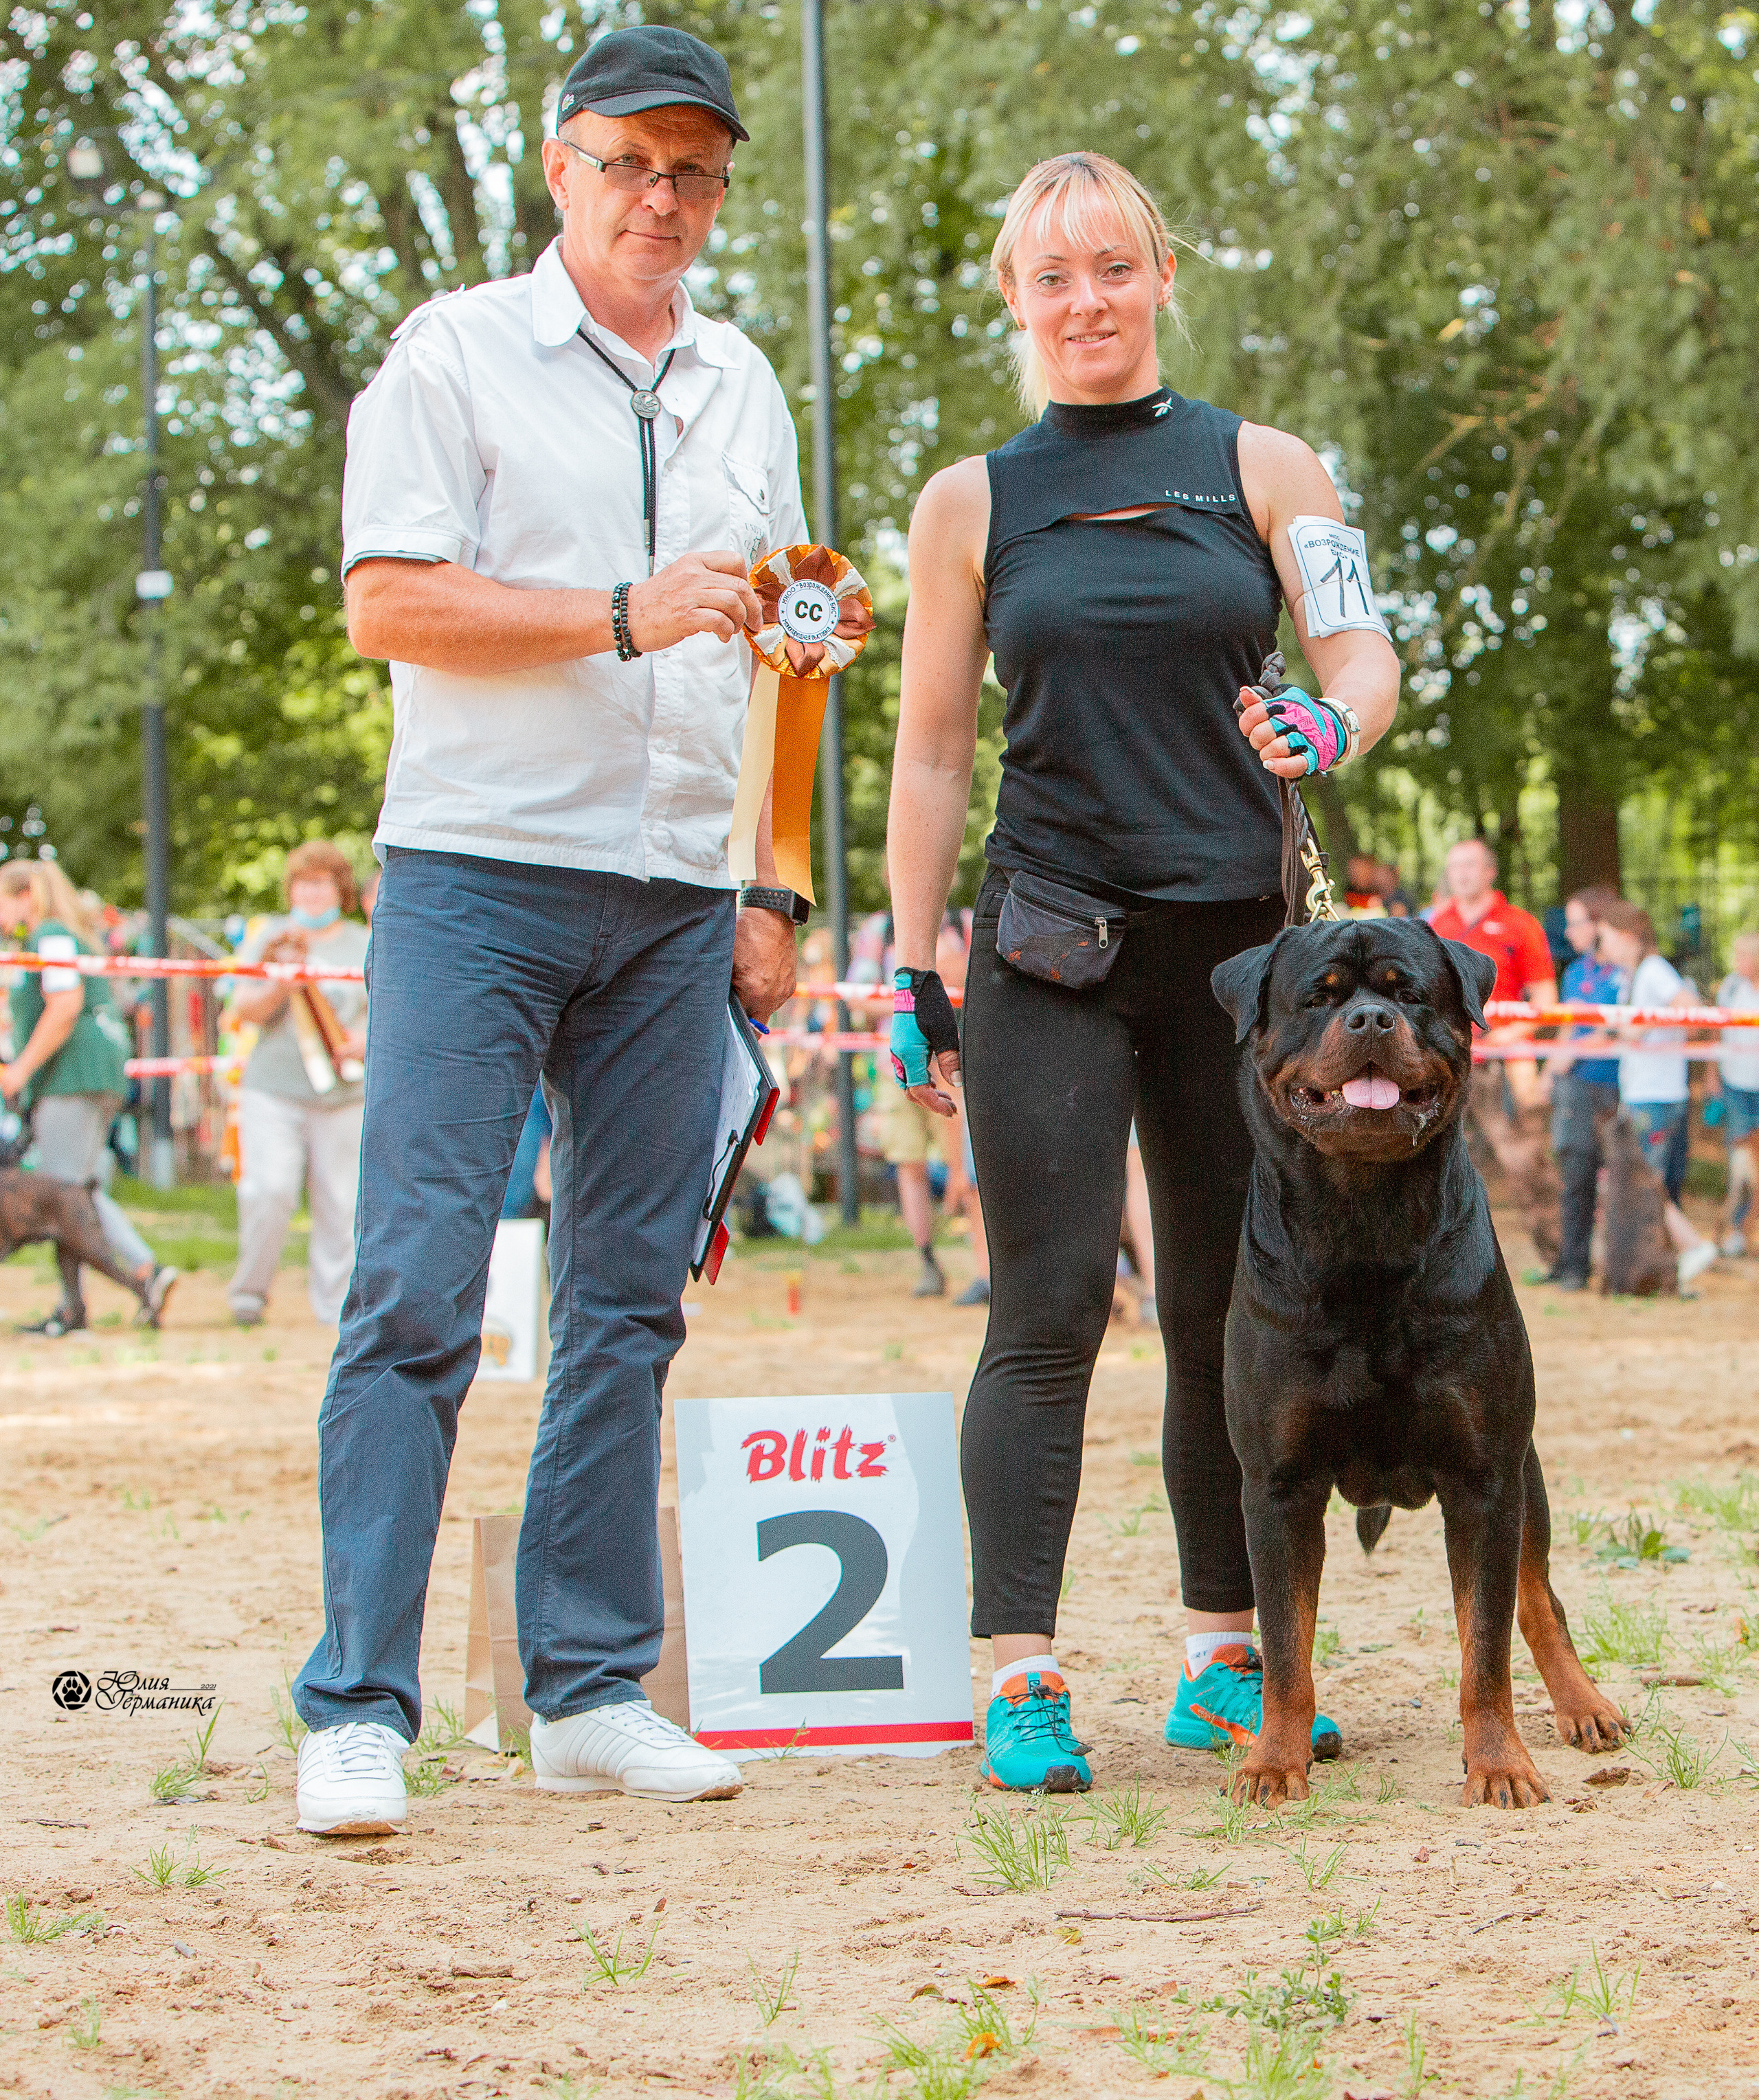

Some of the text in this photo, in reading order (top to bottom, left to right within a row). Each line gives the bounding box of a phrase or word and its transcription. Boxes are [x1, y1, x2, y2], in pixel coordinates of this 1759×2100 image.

[1165, 490, 1236, 503] LES MILLS
[1319, 556, 1370, 618] 11
[740, 1424, 890, 1484] Blitz
[757, 1510, 904, 1695] 2
